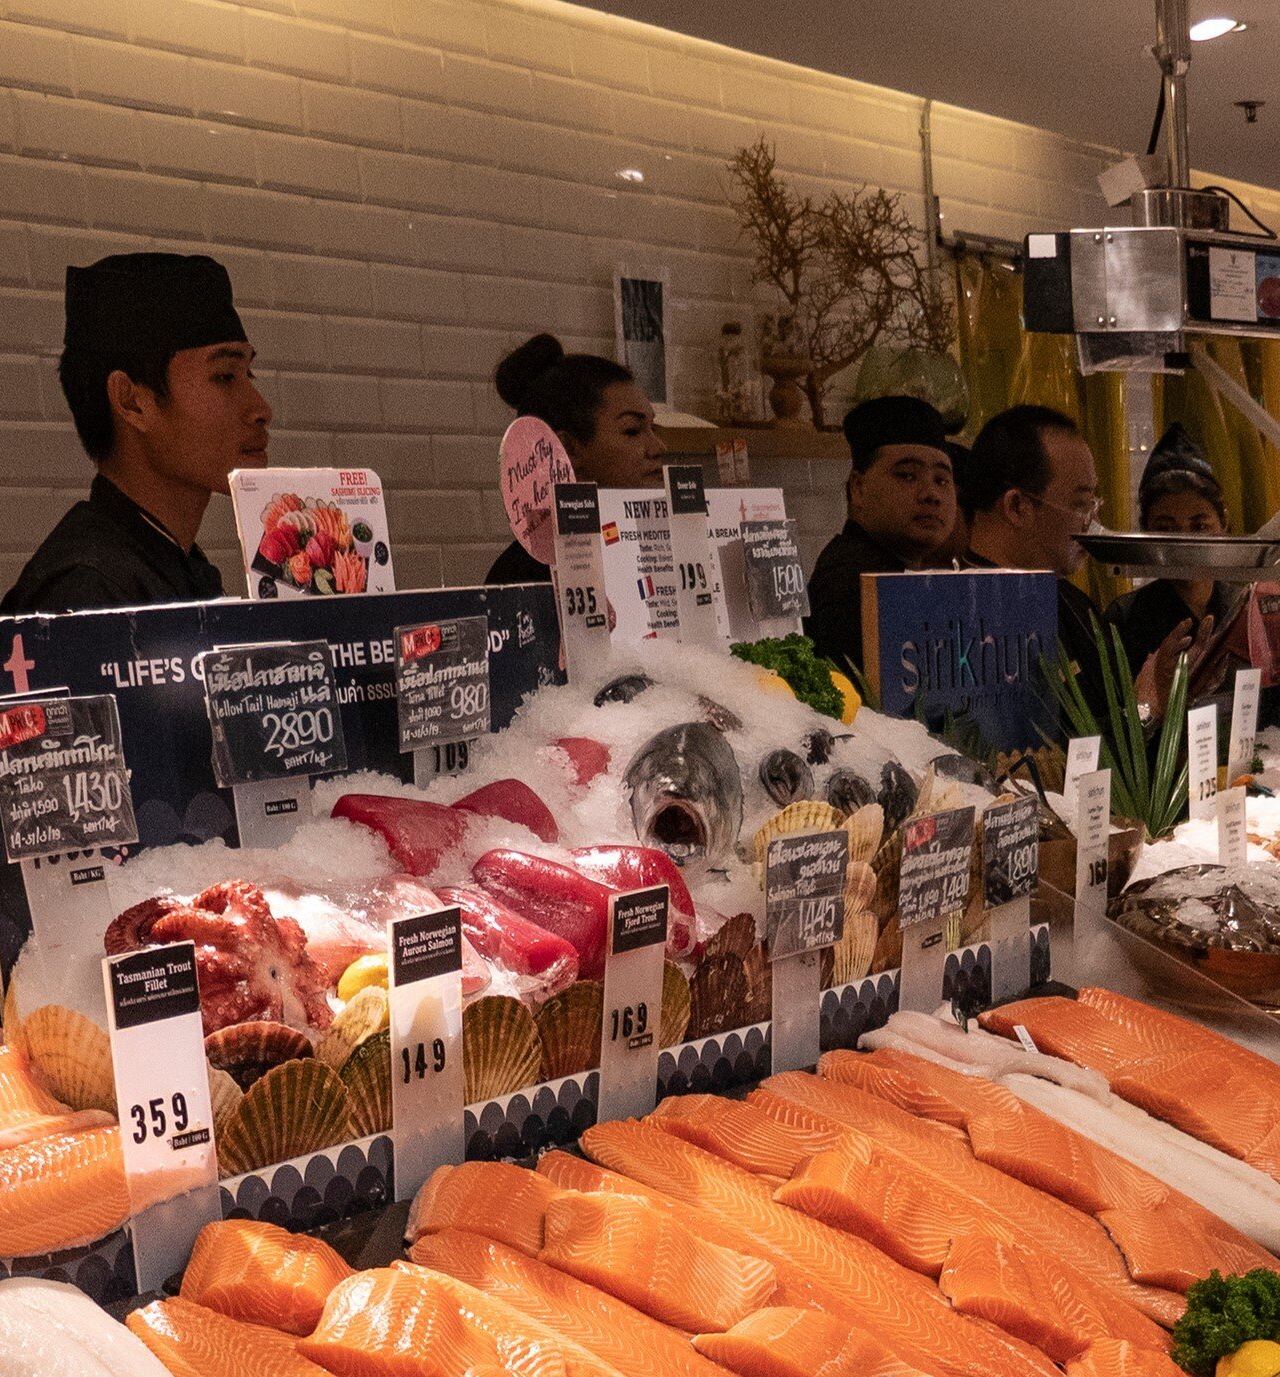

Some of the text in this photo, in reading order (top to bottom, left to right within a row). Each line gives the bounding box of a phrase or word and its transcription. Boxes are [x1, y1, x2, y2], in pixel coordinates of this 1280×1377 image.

[507, 437, 554, 493] Must Try
[339, 472, 368, 486] FREE!
[623, 501, 651, 519] NEW
[620, 531, 641, 542] FRESH
[715, 528, 740, 539] BREAM
[679, 562, 708, 591] 199
[772, 564, 805, 602] 1,590
[565, 586, 597, 616] 335
[656, 586, 677, 597] FRESH
[328, 643, 367, 668] THE
[450, 682, 488, 720] 980
[262, 707, 335, 758] 2,890
[62, 771, 122, 823] 1,430
[618, 901, 665, 920] Fresh Norwegian
[641, 912, 658, 924] Trout
[398, 925, 457, 947] Fresh Norwegian
[402, 945, 428, 958] Aurora
[428, 937, 454, 951] Salmon
[116, 960, 192, 986] Tasmanian Trout
[144, 979, 168, 993] Fillet
[611, 1001, 648, 1041] 169
[402, 1038, 446, 1084] 149
[130, 1092, 189, 1145] 359
